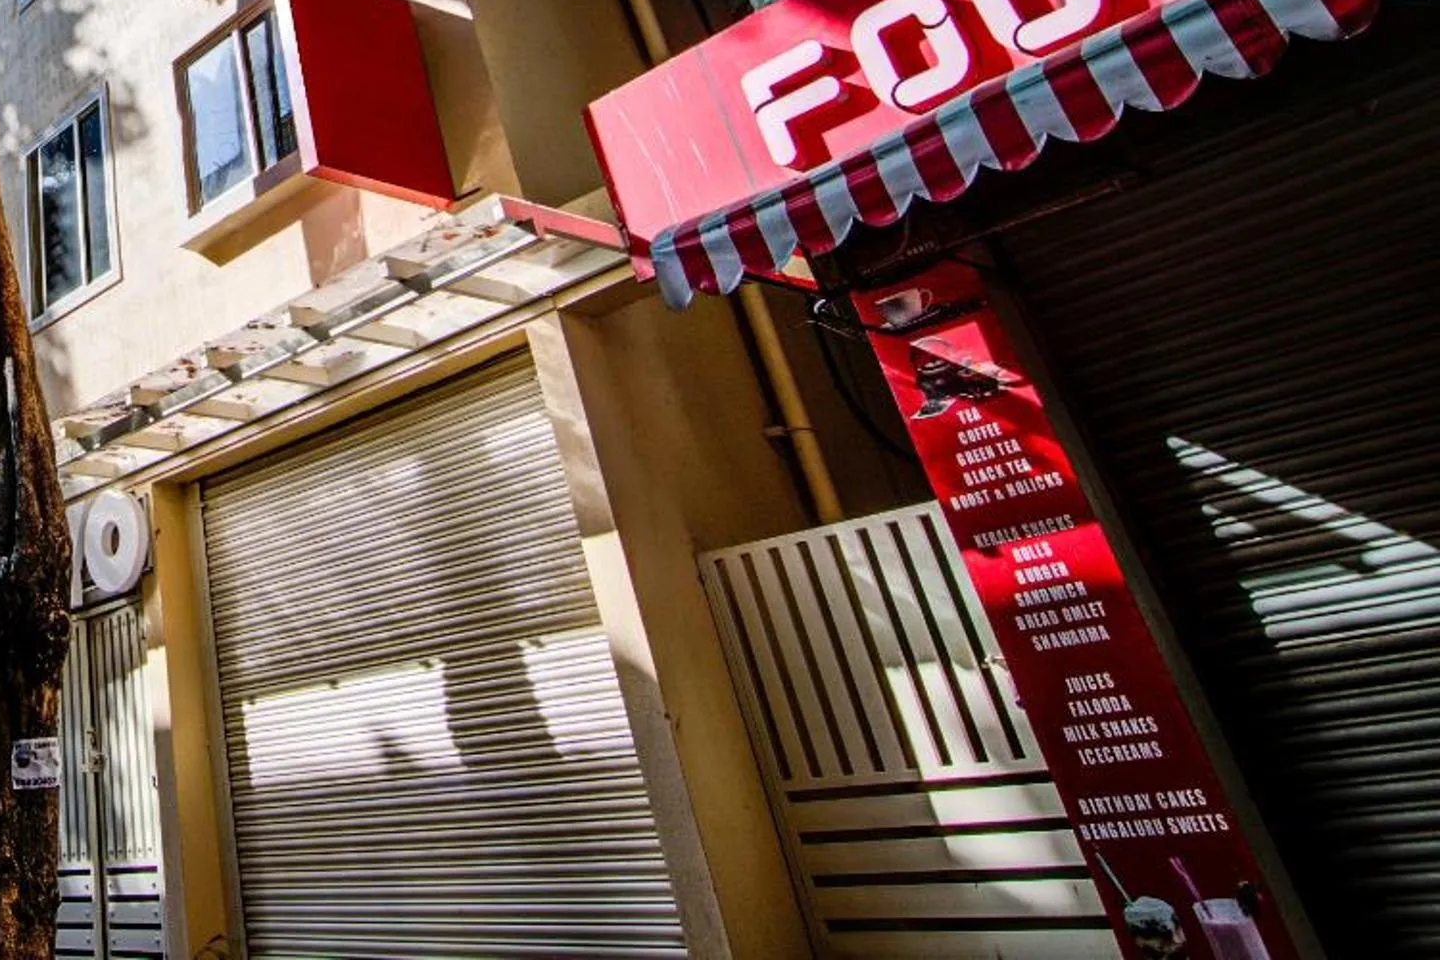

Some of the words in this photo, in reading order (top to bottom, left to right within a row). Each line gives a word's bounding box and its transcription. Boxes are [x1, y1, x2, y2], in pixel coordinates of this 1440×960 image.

[957, 406, 982, 424] TEA
[958, 422, 1002, 445] COFFEE
[956, 444, 996, 467] GREEN
[996, 439, 1022, 456] TEA
[963, 464, 1006, 487] BLACK
[1006, 457, 1032, 475] TEA
[950, 489, 991, 511] BOOST
[973, 526, 1021, 548] KERALA
[1021, 514, 1075, 538] SNACKS
[1014, 561, 1069, 585] BURGER
[1014, 581, 1087, 608] SANDWICH
[1015, 610, 1059, 631] BREAD
[1062, 600, 1106, 622] OMLET
[1065, 672, 1115, 694] JUICES
[1068, 694, 1133, 718] FALOODA
[1063, 723, 1100, 743] MILK
[1101, 716, 1159, 738] SHAKES
[1078, 741, 1163, 766] ICECREAMS
[1077, 793, 1153, 816] BIRTHDAY
[1156, 788, 1207, 809] CAKES
[1079, 819, 1165, 841] BENGALURU
[1167, 812, 1230, 835] SWEETS
